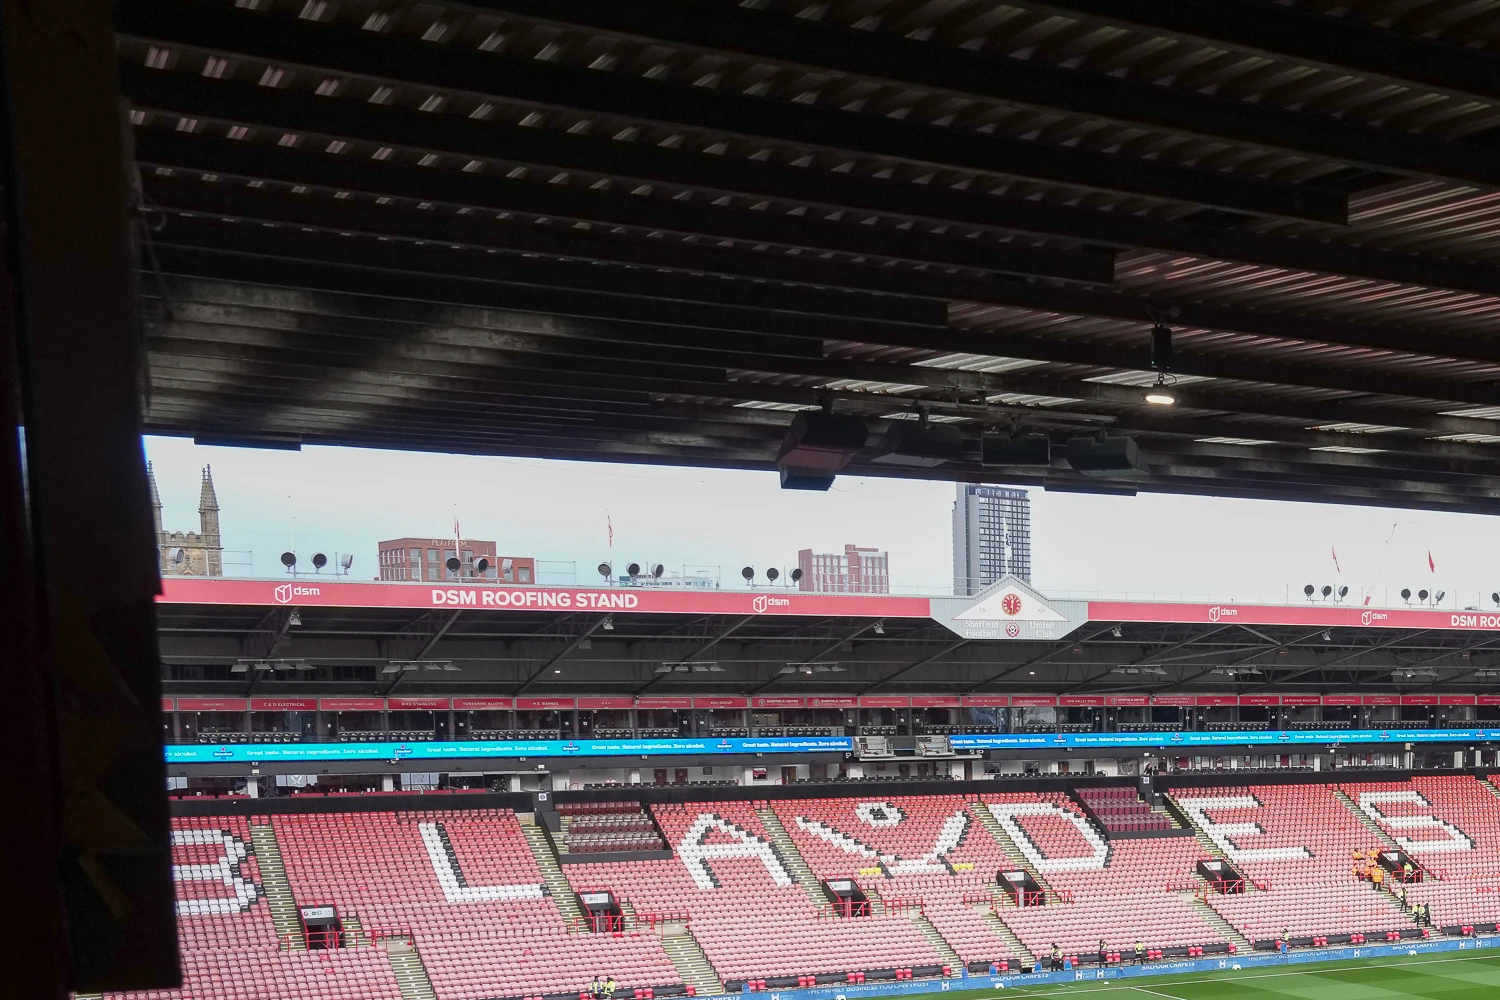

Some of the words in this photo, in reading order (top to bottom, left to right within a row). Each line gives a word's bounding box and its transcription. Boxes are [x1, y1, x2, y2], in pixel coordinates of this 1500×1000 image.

[294, 586, 320, 596] dsm
[432, 590, 477, 605] DSM
[482, 591, 571, 607] ROOFING
[576, 593, 638, 608] STAND
[768, 598, 789, 606] dsm
[1220, 608, 1237, 616] dsm
[1372, 612, 1387, 620] dsm
[965, 621, 998, 629] Sheffield
[1030, 621, 1054, 629] United
[1451, 615, 1476, 627] DSM
[966, 629, 997, 638] Football
[1036, 629, 1054, 638] Club
